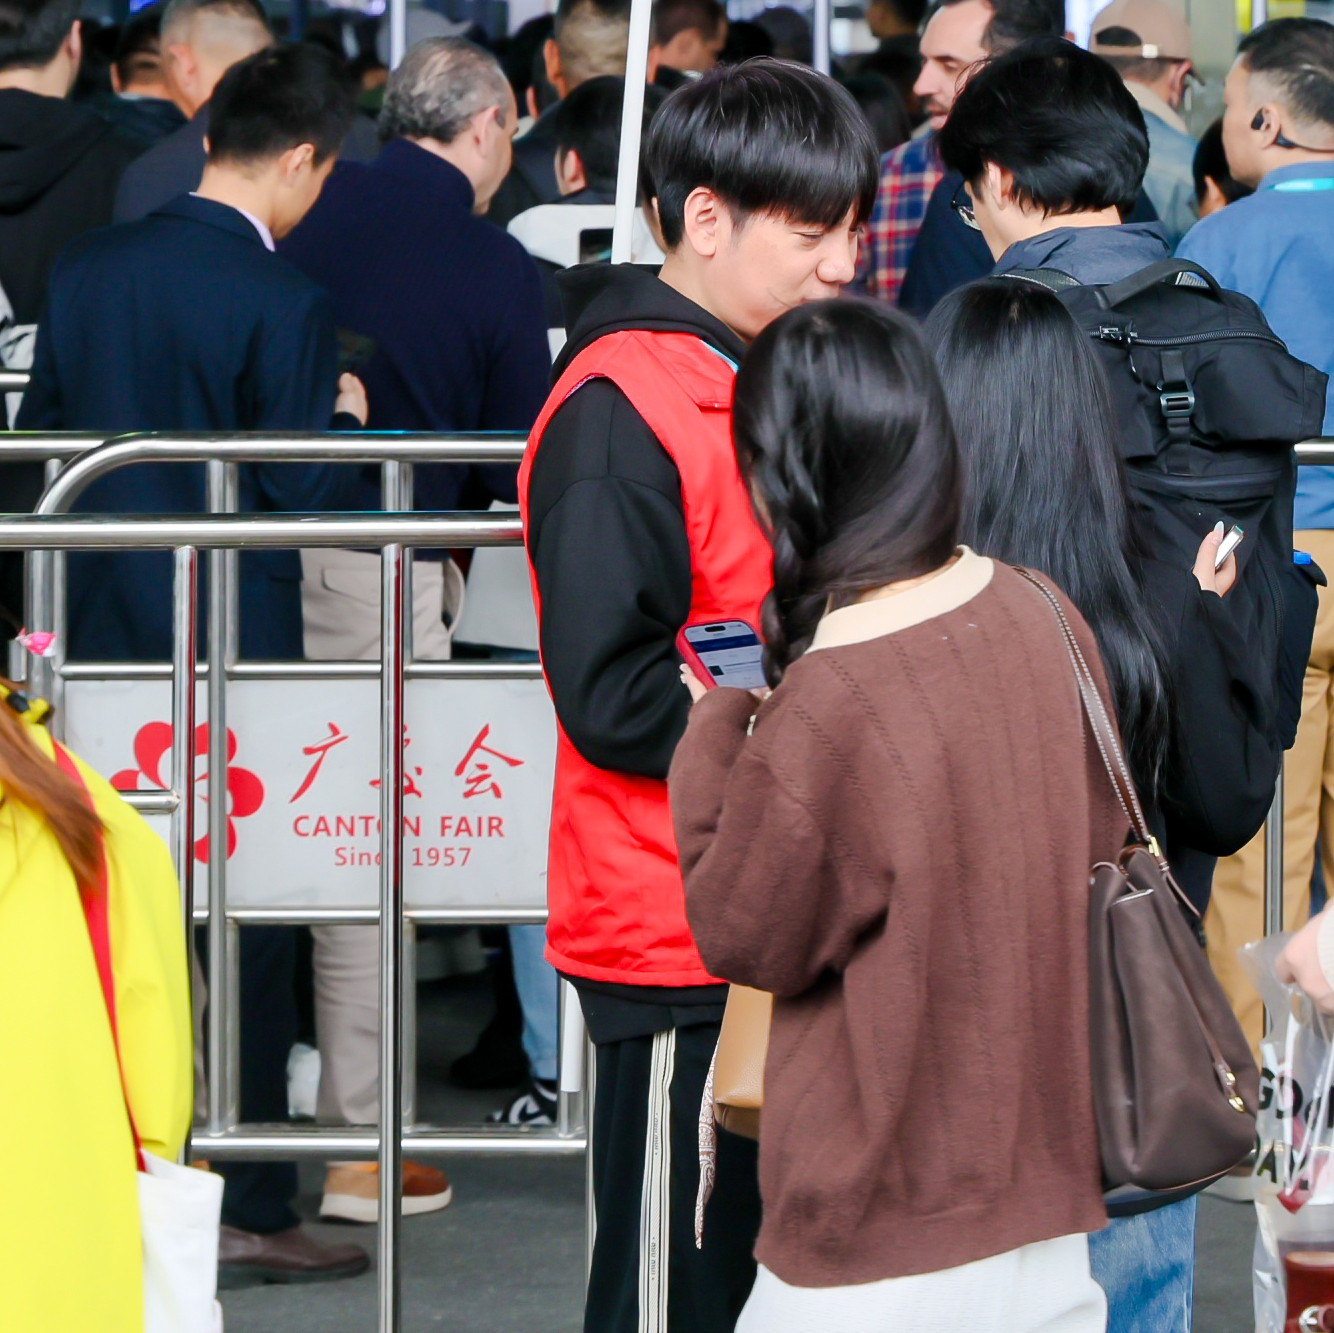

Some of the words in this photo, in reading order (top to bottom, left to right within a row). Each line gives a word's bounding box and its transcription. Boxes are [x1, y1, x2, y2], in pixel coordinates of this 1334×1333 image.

[292, 815, 420, 837] CANTN
[440, 816, 505, 837] FAIR
[412, 848, 472, 866] 1957
